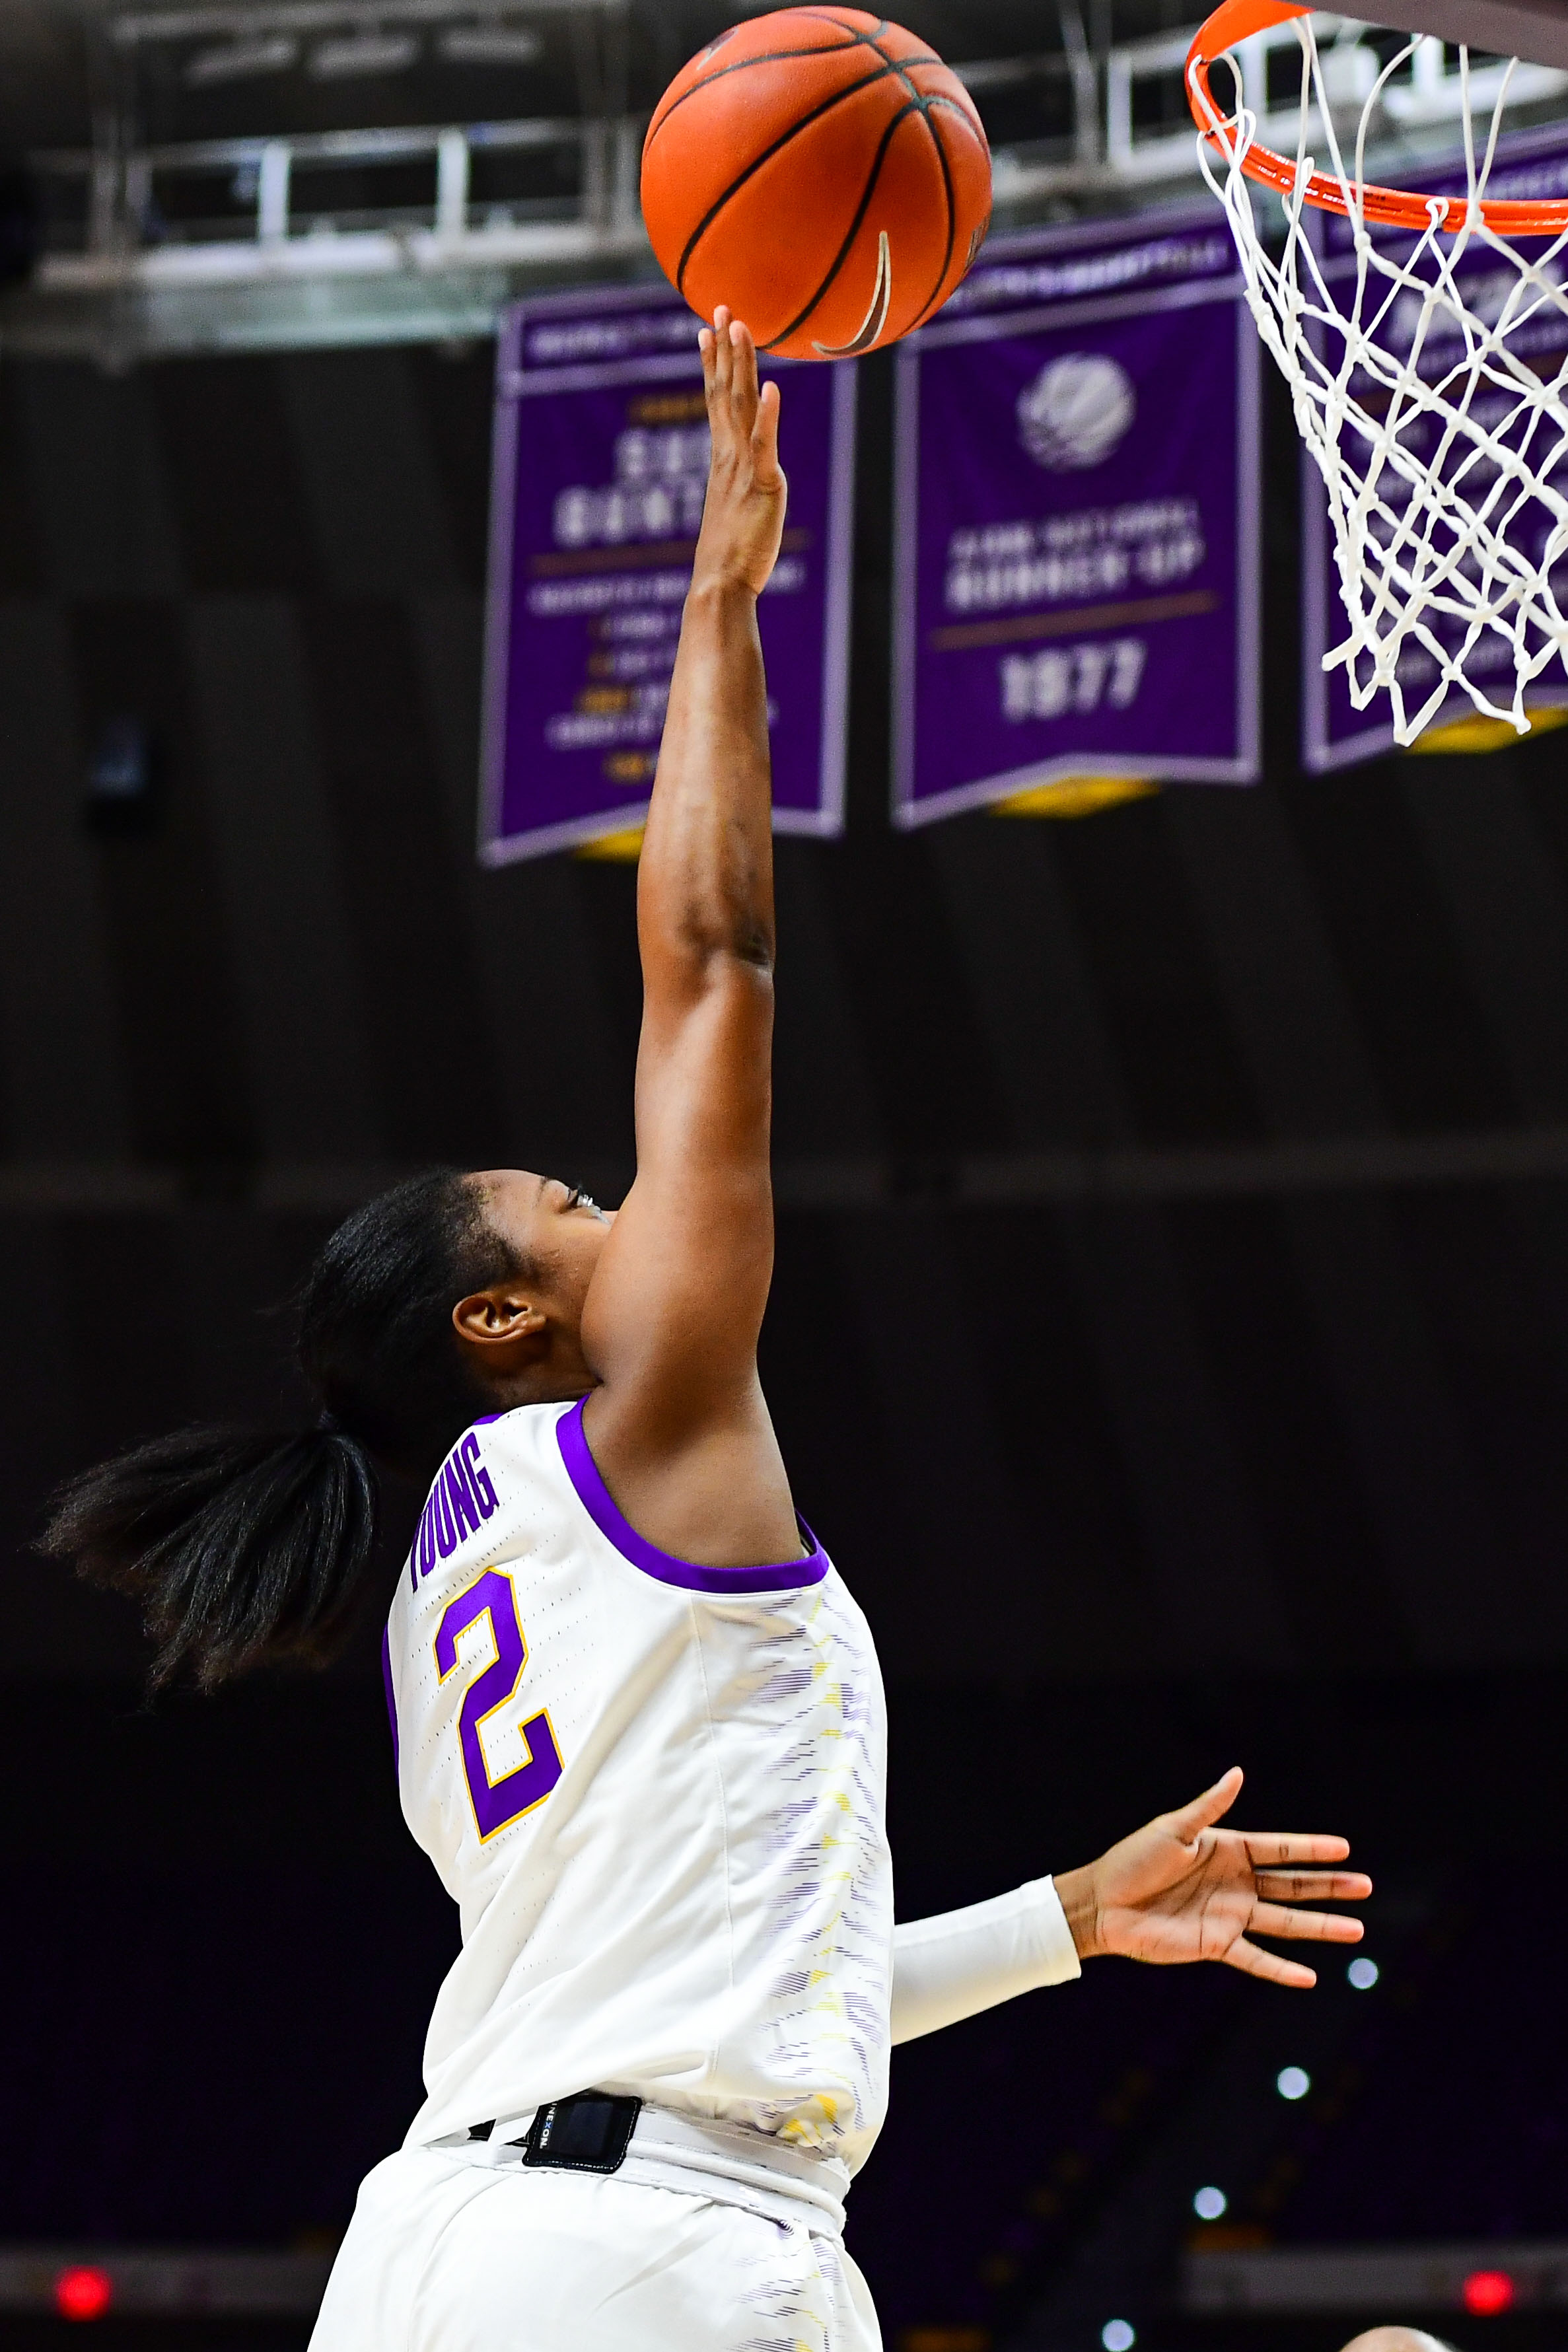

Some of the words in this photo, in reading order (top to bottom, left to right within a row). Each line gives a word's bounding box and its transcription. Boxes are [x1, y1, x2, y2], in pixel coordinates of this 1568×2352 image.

[1001, 638, 1146, 721] 1977
[433, 1565, 565, 1844] 2
[539, 2102, 557, 2149] INEXON
